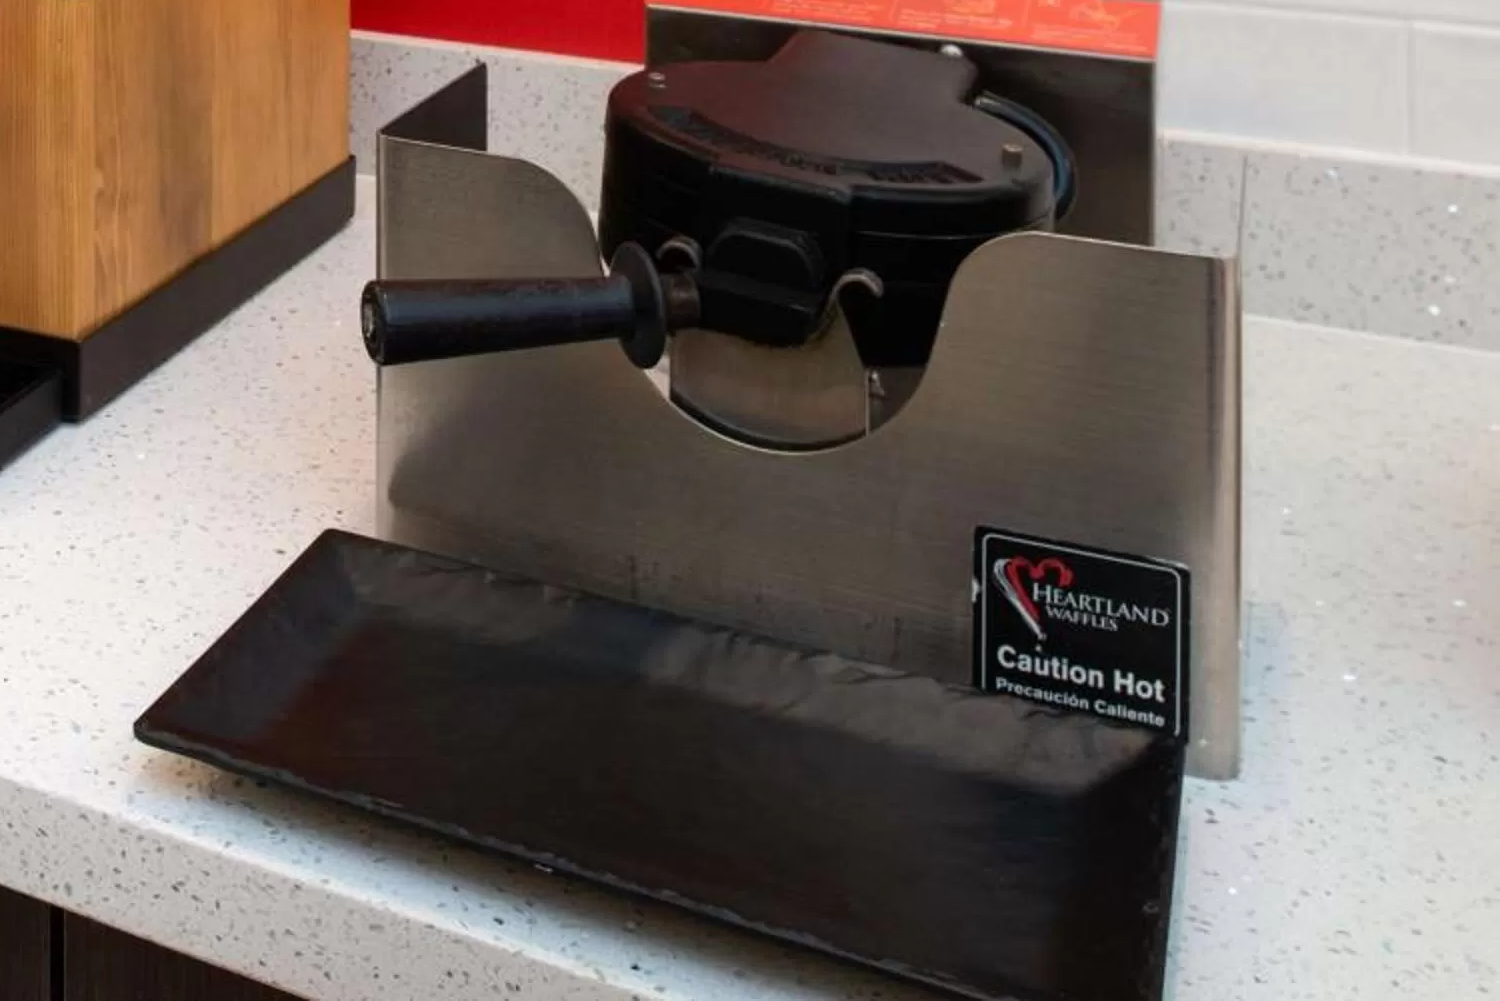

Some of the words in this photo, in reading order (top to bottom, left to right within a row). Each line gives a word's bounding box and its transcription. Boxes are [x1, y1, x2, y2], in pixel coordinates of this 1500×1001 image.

[1032, 581, 1171, 627] HEARTLAND
[1046, 605, 1119, 632] WAFFLES
[996, 645, 1105, 689] Caution
[1113, 669, 1167, 704] Hot
[995, 676, 1090, 711] Precaución
[1094, 699, 1166, 728] Caliente
